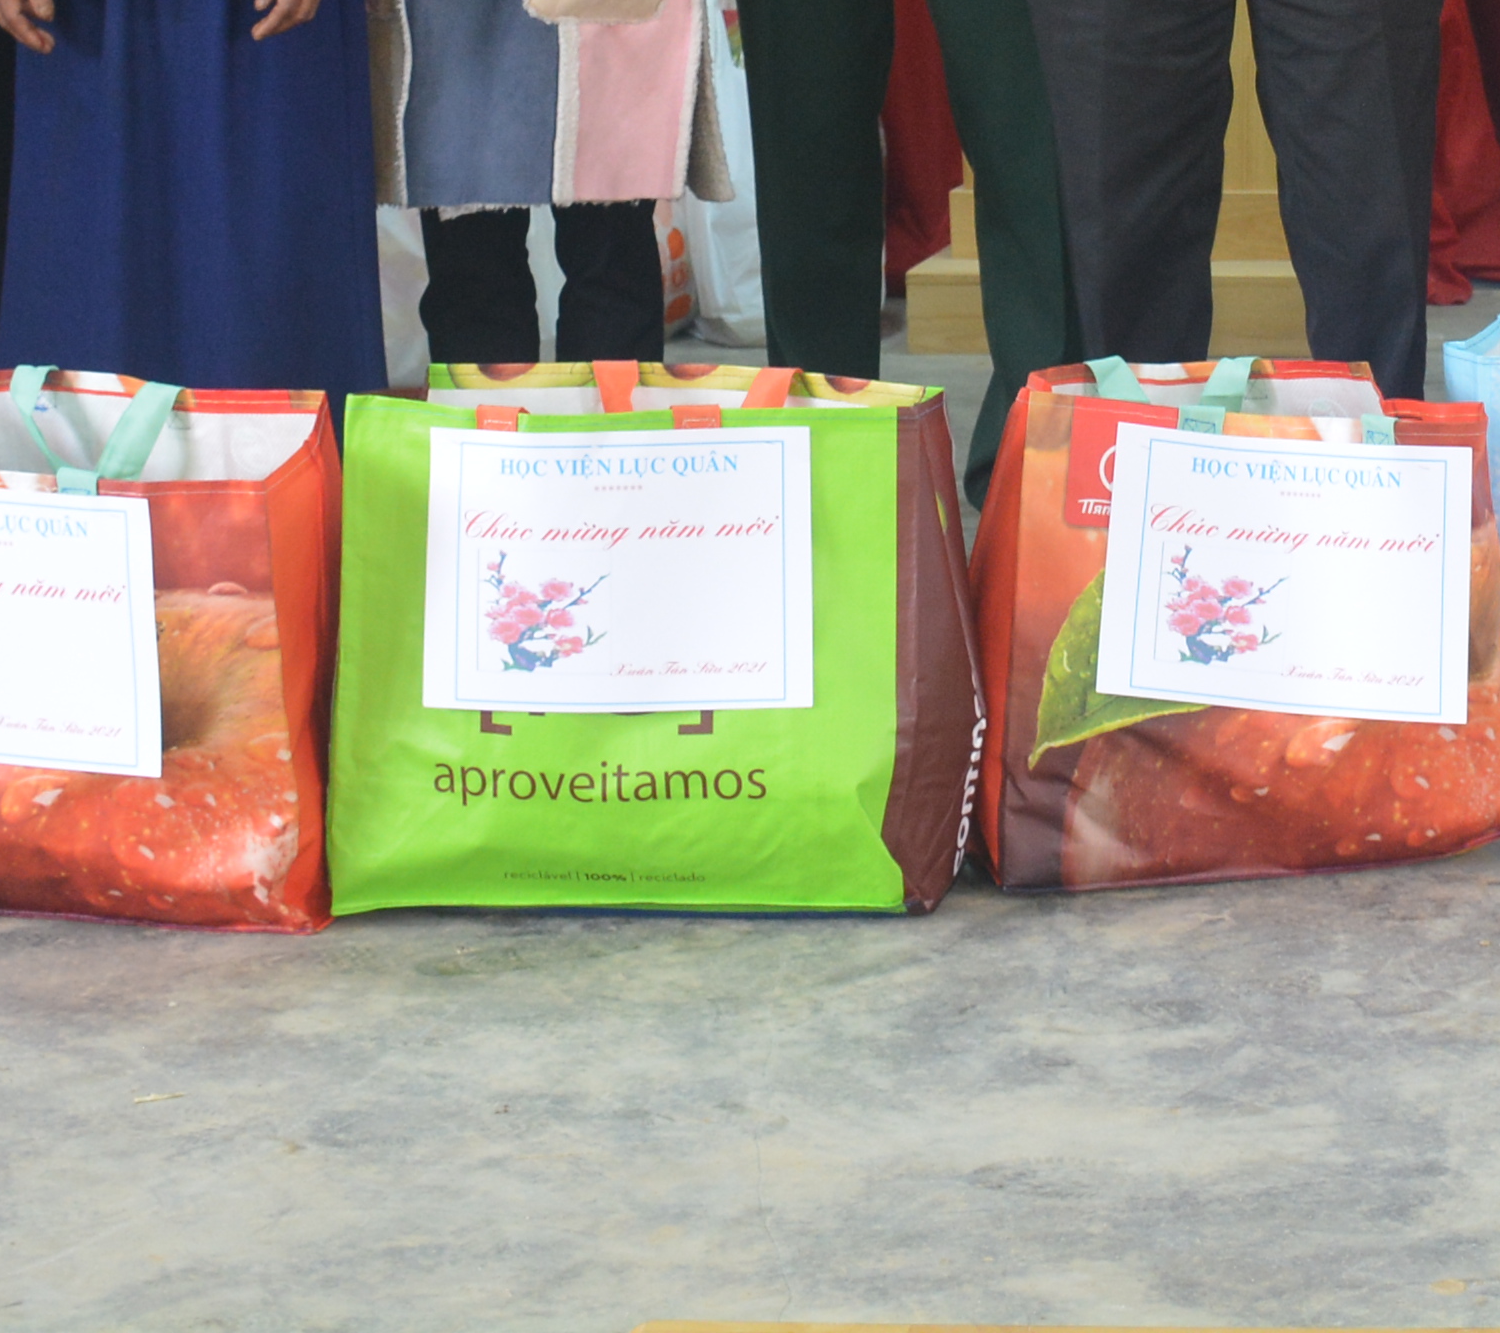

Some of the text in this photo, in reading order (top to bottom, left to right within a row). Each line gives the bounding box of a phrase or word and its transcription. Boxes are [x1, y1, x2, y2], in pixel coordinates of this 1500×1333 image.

[500, 451, 738, 478] HỌC VIỆN LỤC QUÂN
[1191, 457, 1239, 477] HỌC
[1248, 460, 1296, 483] VIỆN
[1302, 467, 1340, 486] LỤC
[464, 510, 532, 540] Chúc
[638, 520, 704, 539] năm
[1150, 504, 1218, 536] Chúc
[433, 760, 767, 806] aproveitamos
[585, 872, 627, 882] 100%
